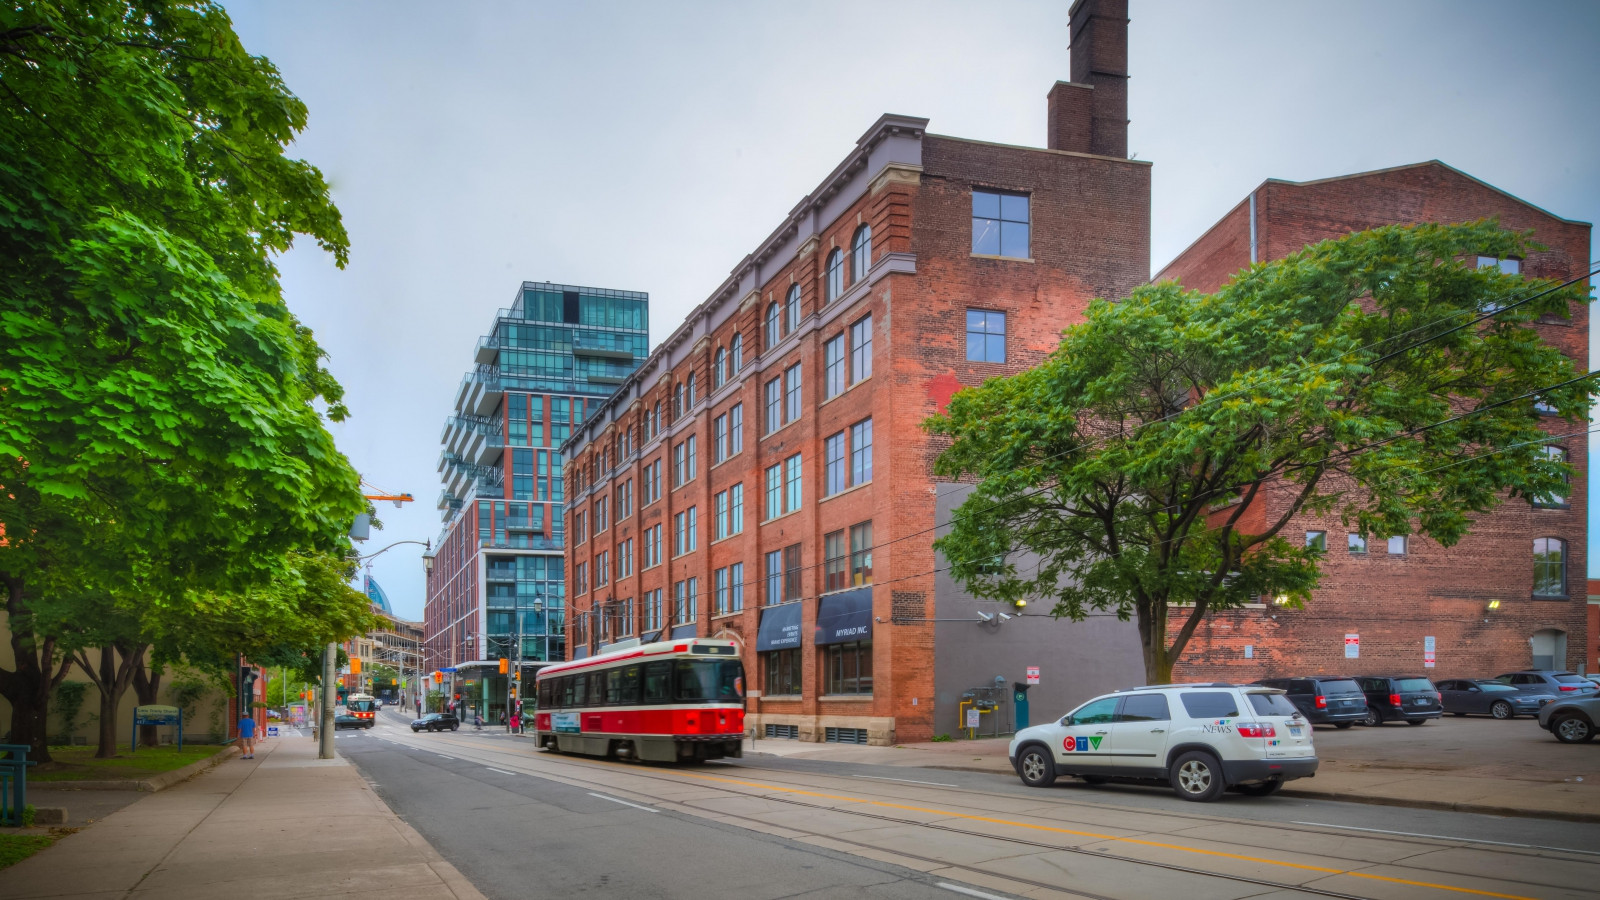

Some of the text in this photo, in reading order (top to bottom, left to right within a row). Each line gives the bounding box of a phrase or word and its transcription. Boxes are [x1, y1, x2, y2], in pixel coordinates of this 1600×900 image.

[835, 625, 868, 637] MYRIAD INC.
[1202, 724, 1232, 734] NEWS
[1063, 736, 1103, 751] CTV
